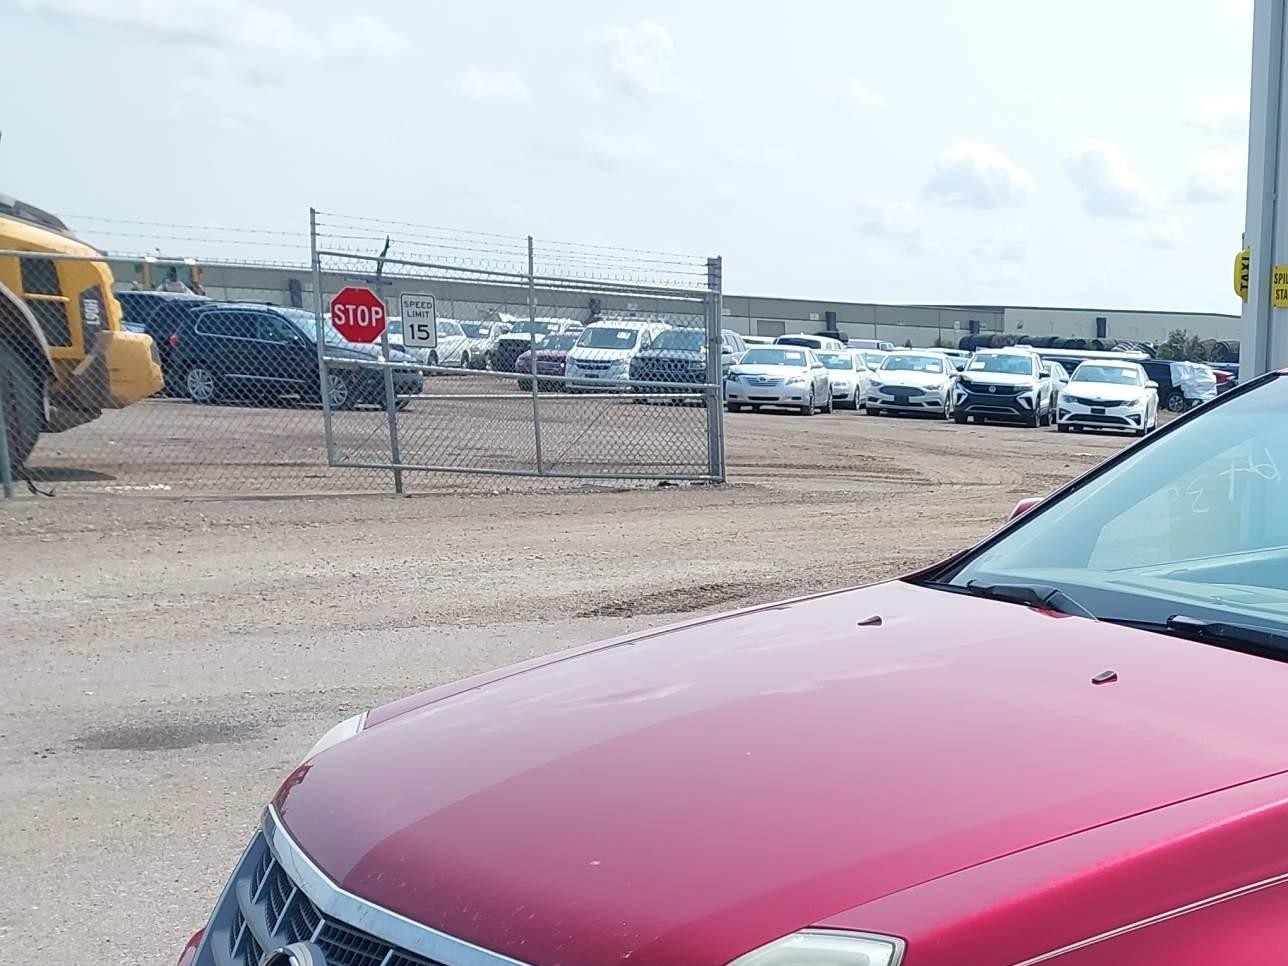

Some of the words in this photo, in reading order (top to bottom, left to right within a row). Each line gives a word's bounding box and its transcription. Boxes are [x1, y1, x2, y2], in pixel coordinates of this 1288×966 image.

[403, 300, 433, 309] SPEED
[334, 304, 383, 328] STOP
[407, 310, 430, 319] LIMIT
[408, 323, 431, 341] 15
